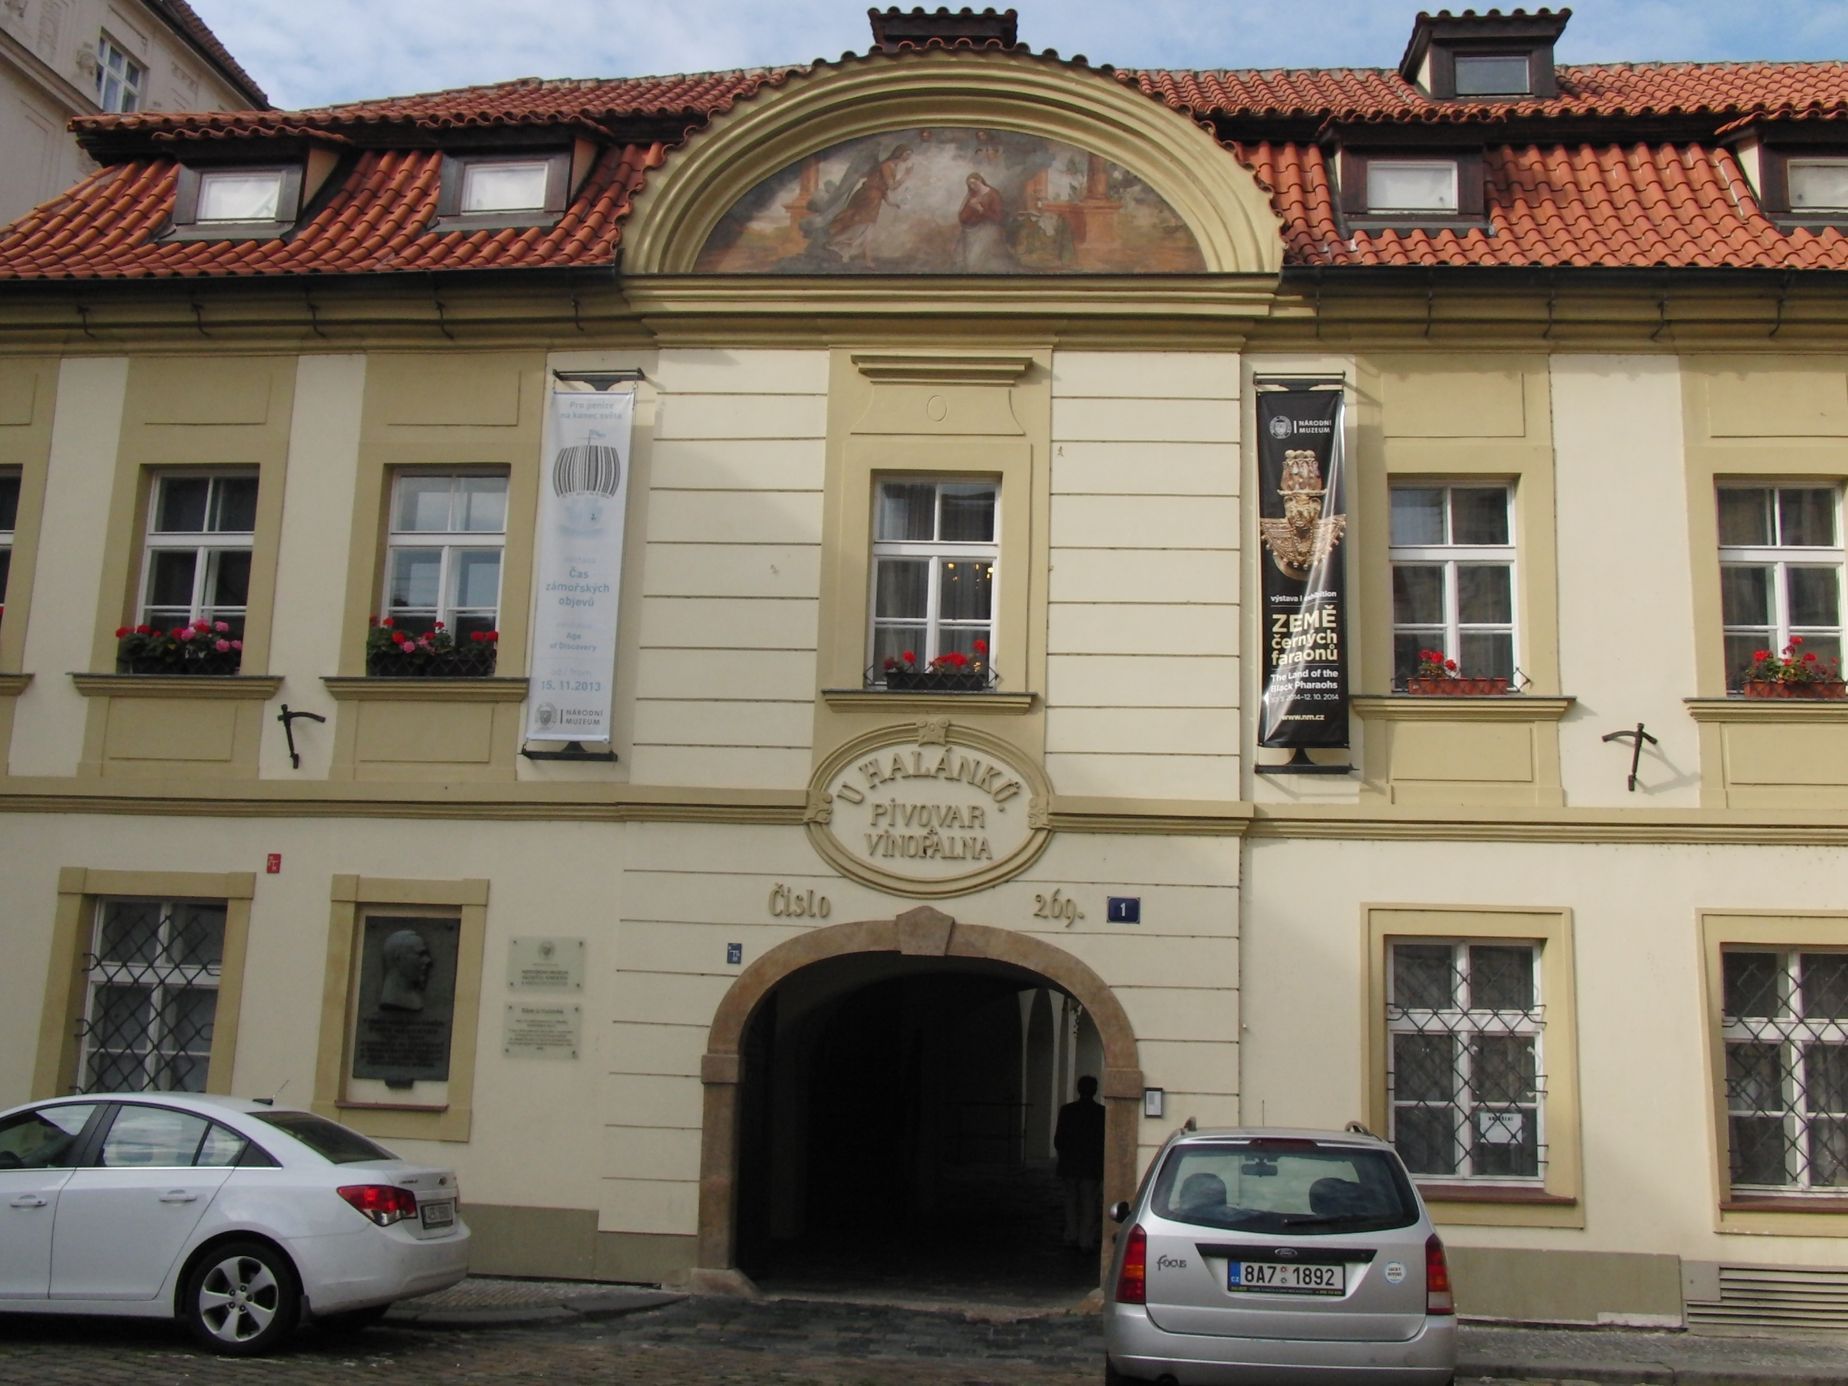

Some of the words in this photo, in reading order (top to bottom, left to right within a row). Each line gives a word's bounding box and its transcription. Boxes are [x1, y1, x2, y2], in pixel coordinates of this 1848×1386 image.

[568, 566, 590, 579] Čas
[545, 580, 610, 595] zámořských
[558, 596, 595, 608] objevů
[1272, 604, 1337, 633] ZEMĚ
[1271, 629, 1338, 649] černých
[1271, 643, 1338, 666] faraonů
[1270, 674, 1287, 683] The
[1287, 669, 1309, 680] Land
[1310, 669, 1321, 678] of
[1322, 669, 1339, 678] the
[541, 680, 556, 691] 15.
[1270, 682, 1293, 693] Black
[1294, 680, 1338, 690] Pharaohs
[565, 718, 601, 726] MUZEUM
[836, 781, 865, 805] U
[869, 798, 986, 829] PIVOVAR
[1119, 902, 1127, 918] 1
[1244, 1265, 1277, 1284] 8A7
[1292, 1267, 1336, 1287] 1892
